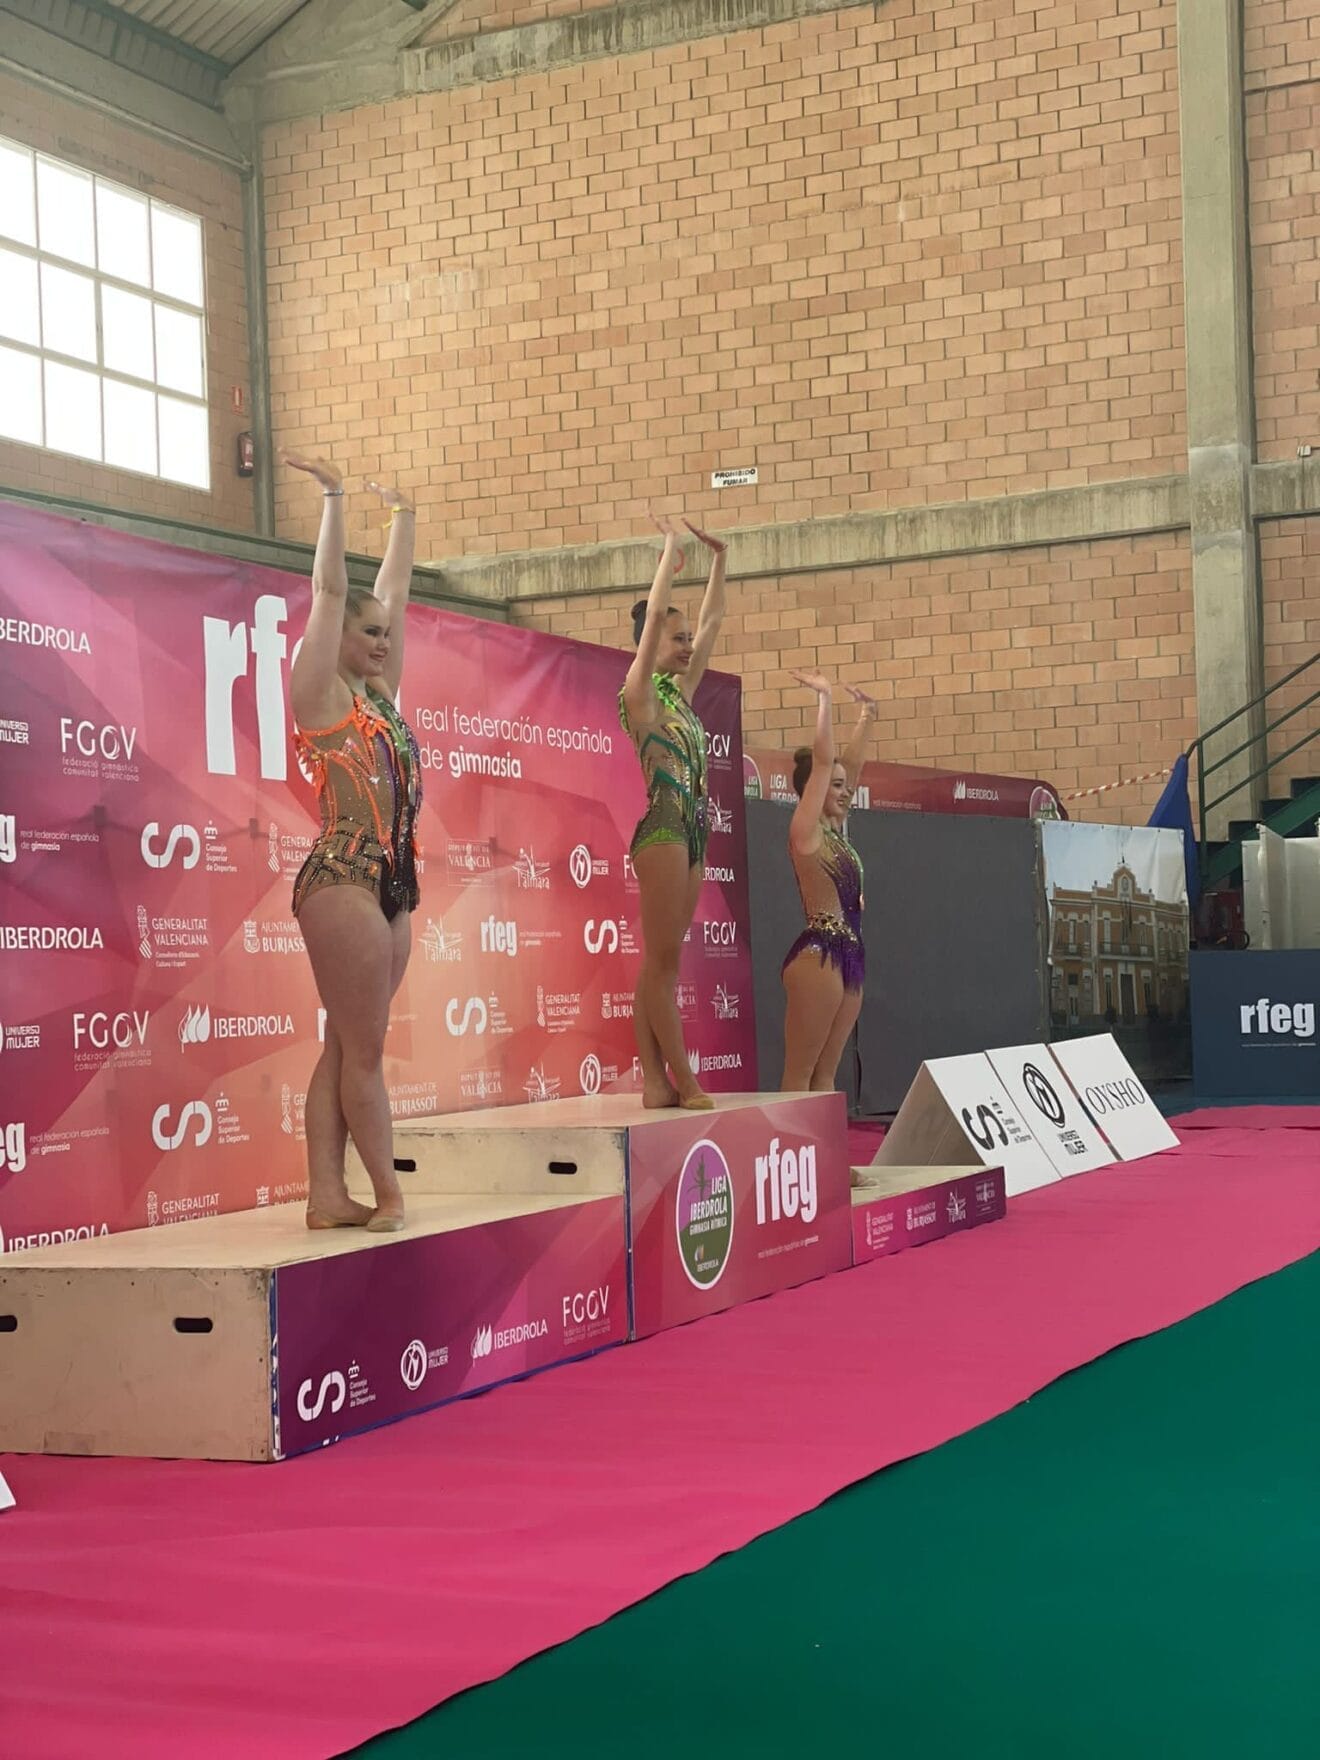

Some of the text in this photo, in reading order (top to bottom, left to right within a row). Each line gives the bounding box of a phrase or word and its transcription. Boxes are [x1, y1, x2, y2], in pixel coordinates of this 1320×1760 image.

[715, 469, 756, 478] PROHIBIDO
[416, 705, 612, 755] real federación española
[420, 741, 522, 779] de gimnasia
[770, 773, 788, 790] LIGA
[966, 788, 999, 801] IBERDROLA
[31, 842, 61, 852] gimnasia
[151, 918, 208, 931] GENERALITAT
[0, 926, 104, 949] IBERDROLA
[154, 933, 209, 946] VALENCIANA
[481, 915, 517, 957] rfeg
[545, 993, 580, 1005] GENERALITAT
[547, 1005, 581, 1016] VALENCIANA
[1240, 998, 1315, 1037] rfeg
[5, 1025, 40, 1036] UNIVERSO
[214, 1014, 295, 1039] IBERDROLA
[6, 1036, 40, 1049] MUJER
[701, 1053, 742, 1073] IBERDROLA
[1085, 1077, 1146, 1115] OYSHO
[41, 1143, 71, 1156] gimnasia
[711, 1175, 728, 1195] LIGA
[755, 1138, 818, 1225] rfeg
[161, 1193, 220, 1214] GENERALITAT
[690, 1196, 728, 1221] IBERDROLA
[494, 1318, 549, 1350] IBERDROLA
[428, 1354, 449, 1369] MUJER
